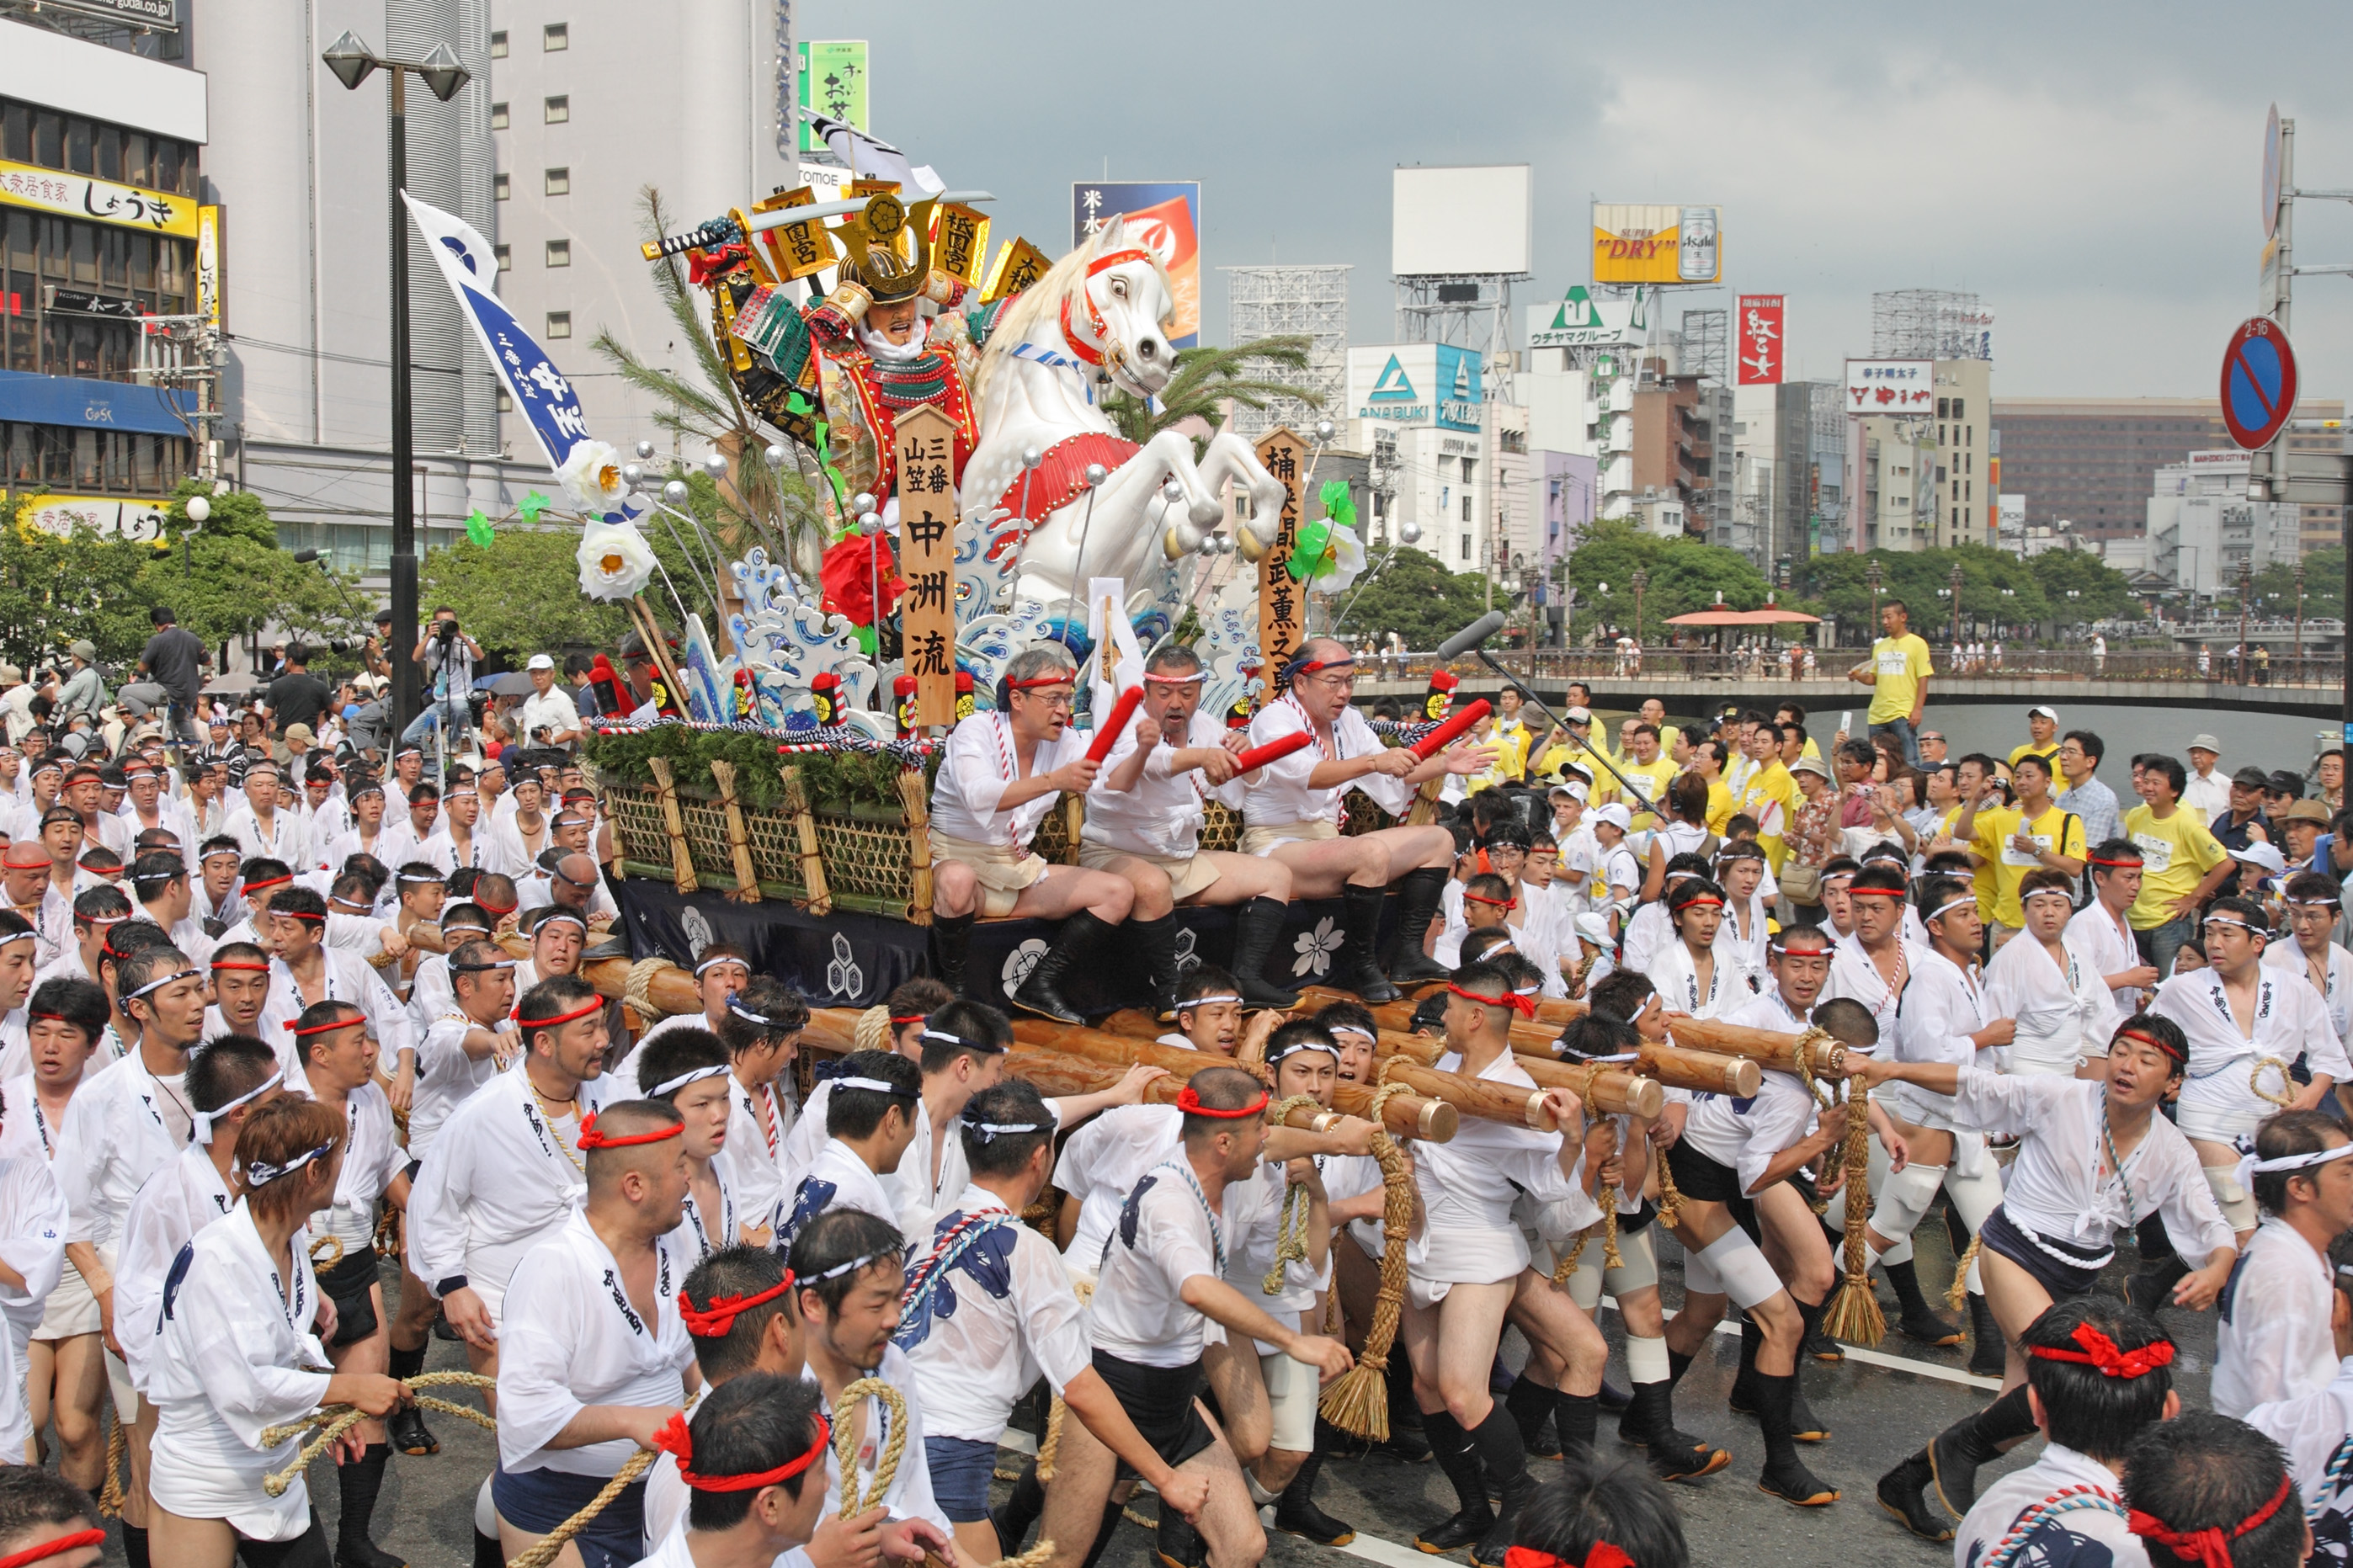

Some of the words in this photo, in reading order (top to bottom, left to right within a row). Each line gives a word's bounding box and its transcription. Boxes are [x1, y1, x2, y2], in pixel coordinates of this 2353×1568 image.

[799, 170, 838, 186] TOMOE
[0, 172, 68, 203] 大衆居食家
[84, 180, 173, 229] しょうき
[1621, 228, 1654, 237] SUPER
[1683, 235, 1715, 248] Asahi
[87, 295, 136, 316] ホース
[1531, 329, 1623, 344] ウチヤマグループ
[2245, 321, 2268, 338] 2-16
[1863, 368, 1918, 379] 辛子明太子
[1875, 385, 1930, 405] やまや
[1359, 406, 1429, 421] ANABUKI
[904, 437, 925, 493] 山笠
[927, 438, 950, 494] 三番
[908, 510, 950, 677] 中洲流
